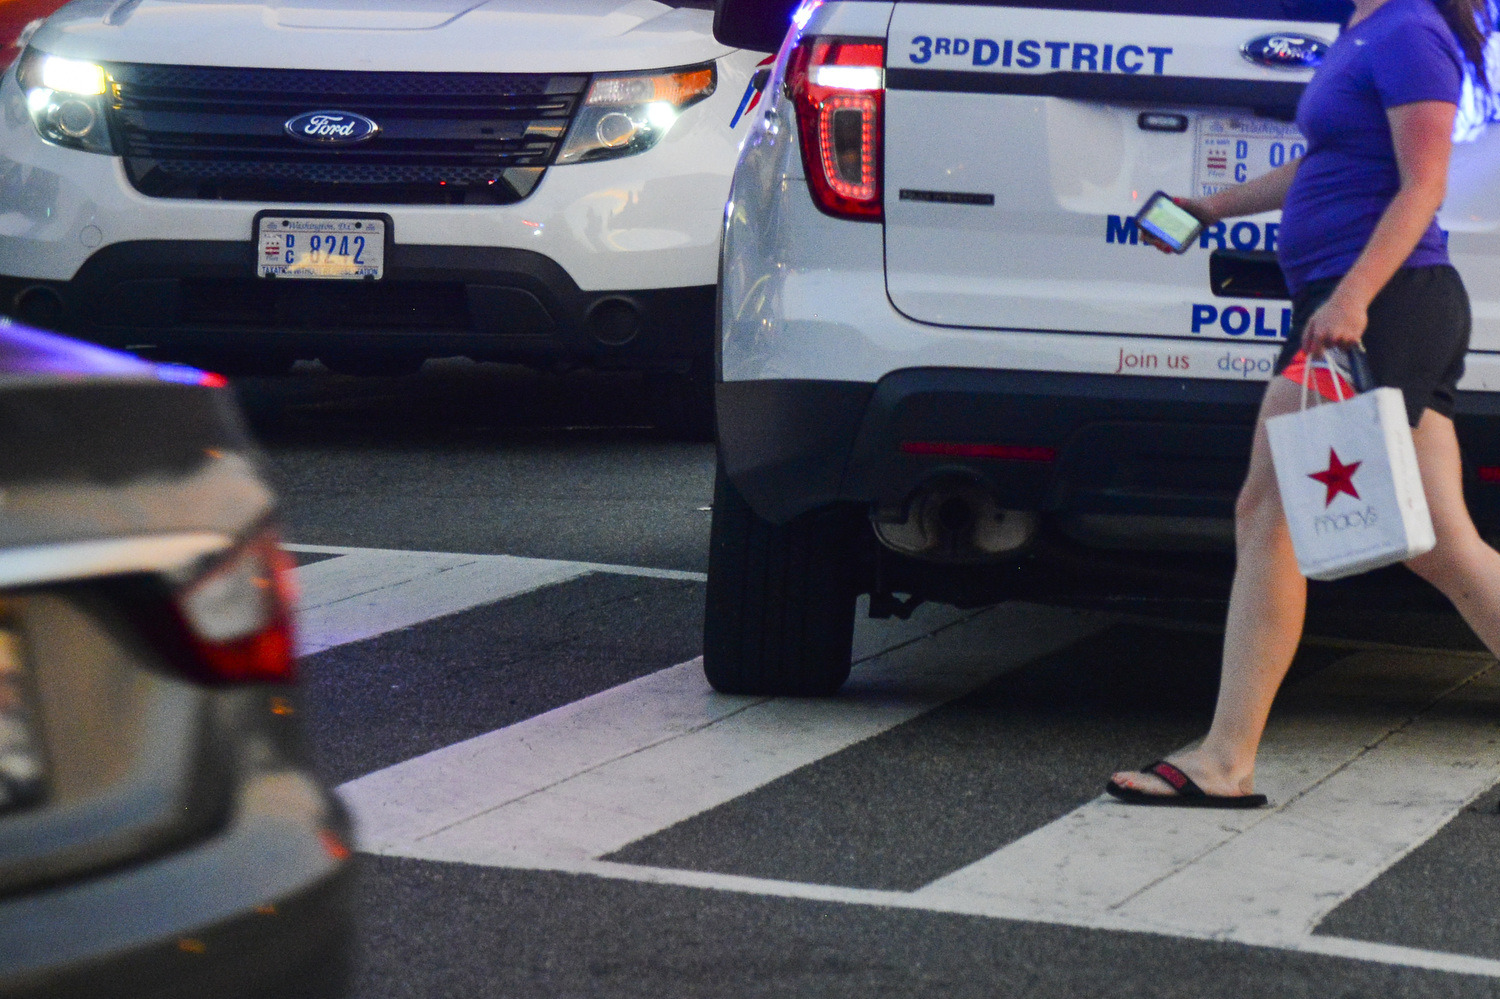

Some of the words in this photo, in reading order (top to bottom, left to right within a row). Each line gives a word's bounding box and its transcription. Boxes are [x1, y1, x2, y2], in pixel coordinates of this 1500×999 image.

[972, 38, 1174, 76] DISTRICT
[304, 115, 355, 136] Ford
[310, 234, 365, 265] 8242
[1168, 354, 1190, 370] us
